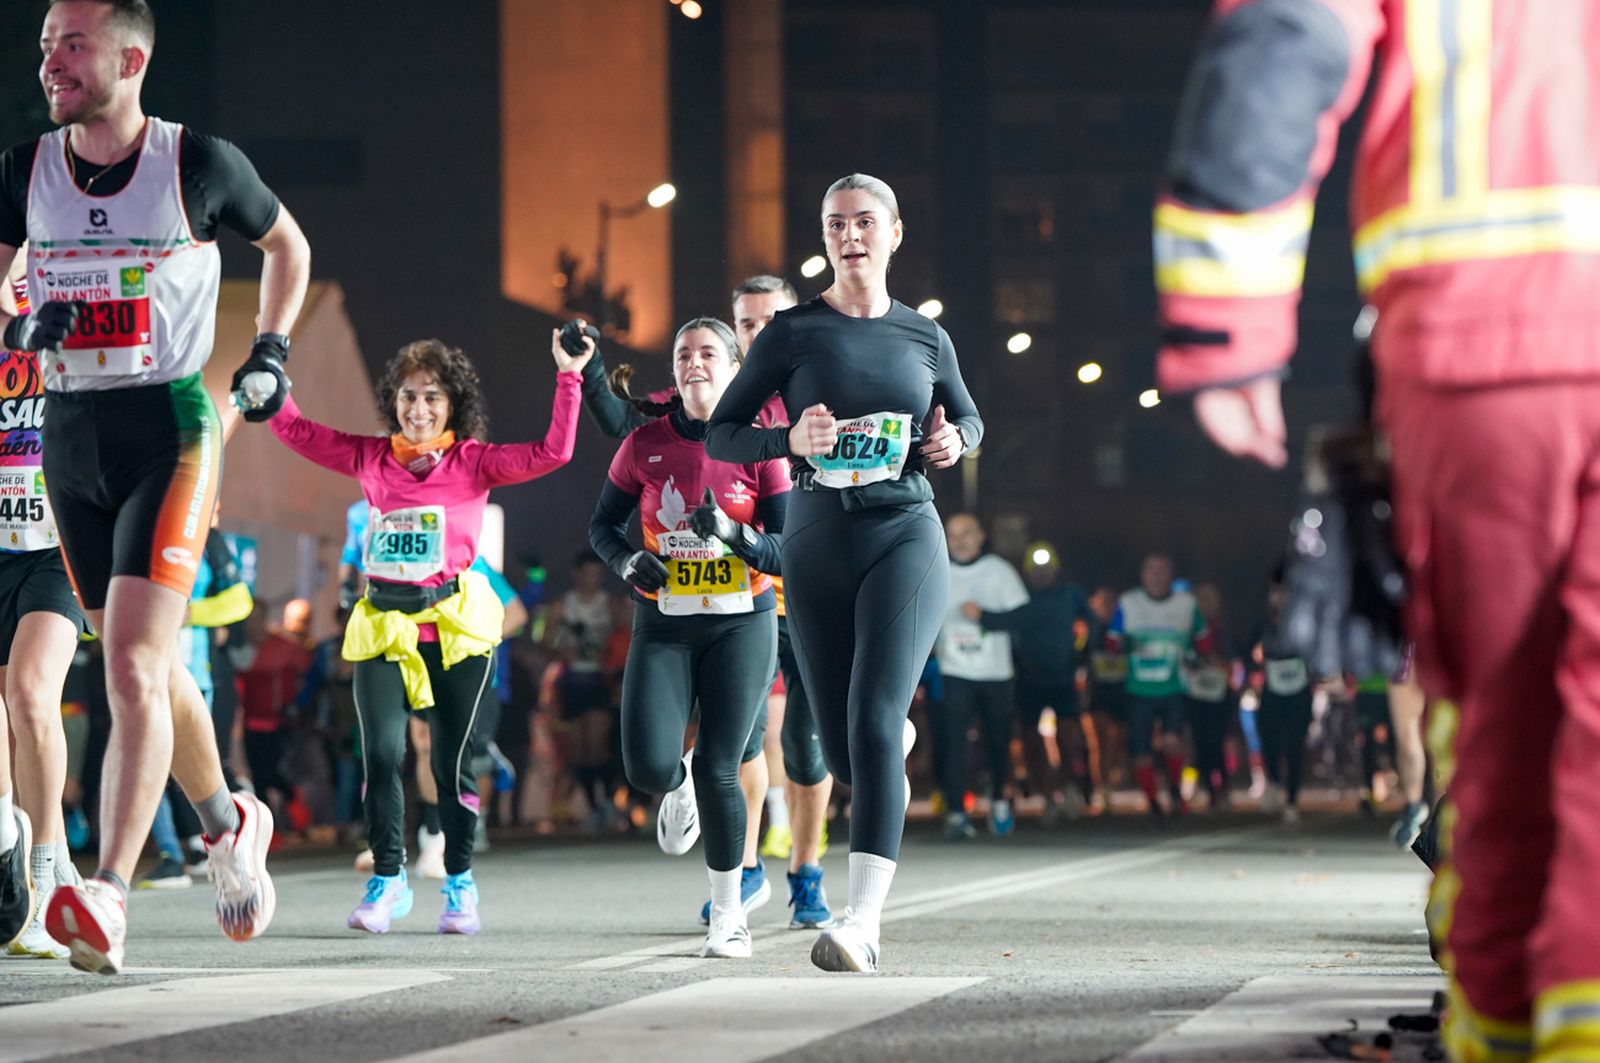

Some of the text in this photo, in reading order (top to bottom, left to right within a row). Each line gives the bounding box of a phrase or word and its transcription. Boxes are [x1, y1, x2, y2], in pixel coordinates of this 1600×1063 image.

[57, 275, 92, 288] NOCHE
[95, 273, 109, 285] DE
[49, 290, 68, 302] SAN
[68, 302, 135, 336] 830
[14, 476, 25, 484] DE
[679, 540, 704, 548] NOCHE
[670, 550, 686, 559] SAN
[677, 560, 732, 586] 5743
